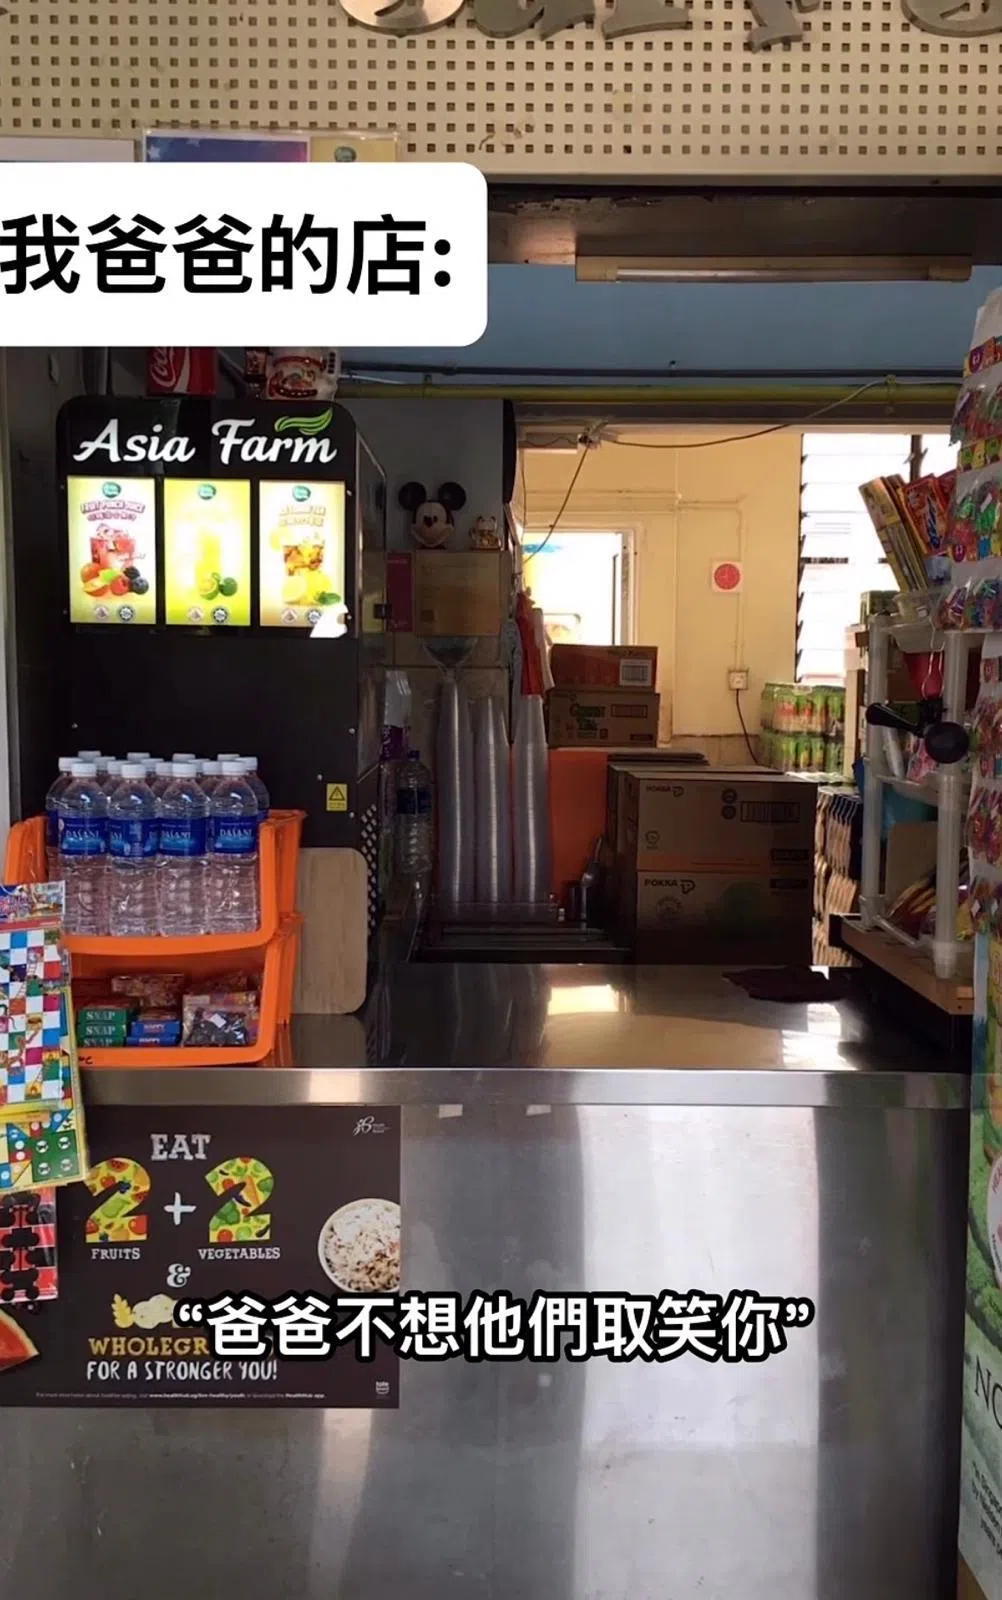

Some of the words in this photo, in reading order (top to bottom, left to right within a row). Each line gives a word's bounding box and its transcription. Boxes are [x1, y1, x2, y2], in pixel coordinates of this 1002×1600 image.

[72, 418, 196, 463] Asia
[211, 416, 337, 465] Farm
[219, 828, 252, 838] DASANI
[644, 878, 678, 887] POKKA
[85, 1010, 116, 1021] SNAP
[85, 1025, 117, 1036] SNAP
[151, 1134, 211, 1161] EAT
[84, 1157, 151, 1243] 2
[204, 1157, 275, 1243] 2
[91, 1247, 141, 1260] FRUITS
[197, 1247, 281, 1260] VEGETABLES
[166, 1263, 192, 1288] &
[88, 1336, 210, 1356] WHOLEGR
[87, 1360, 121, 1381] FOR
[127, 1360, 138, 1380] A
[145, 1361, 233, 1381] STRONGER
[239, 1360, 278, 1381] YOU!
